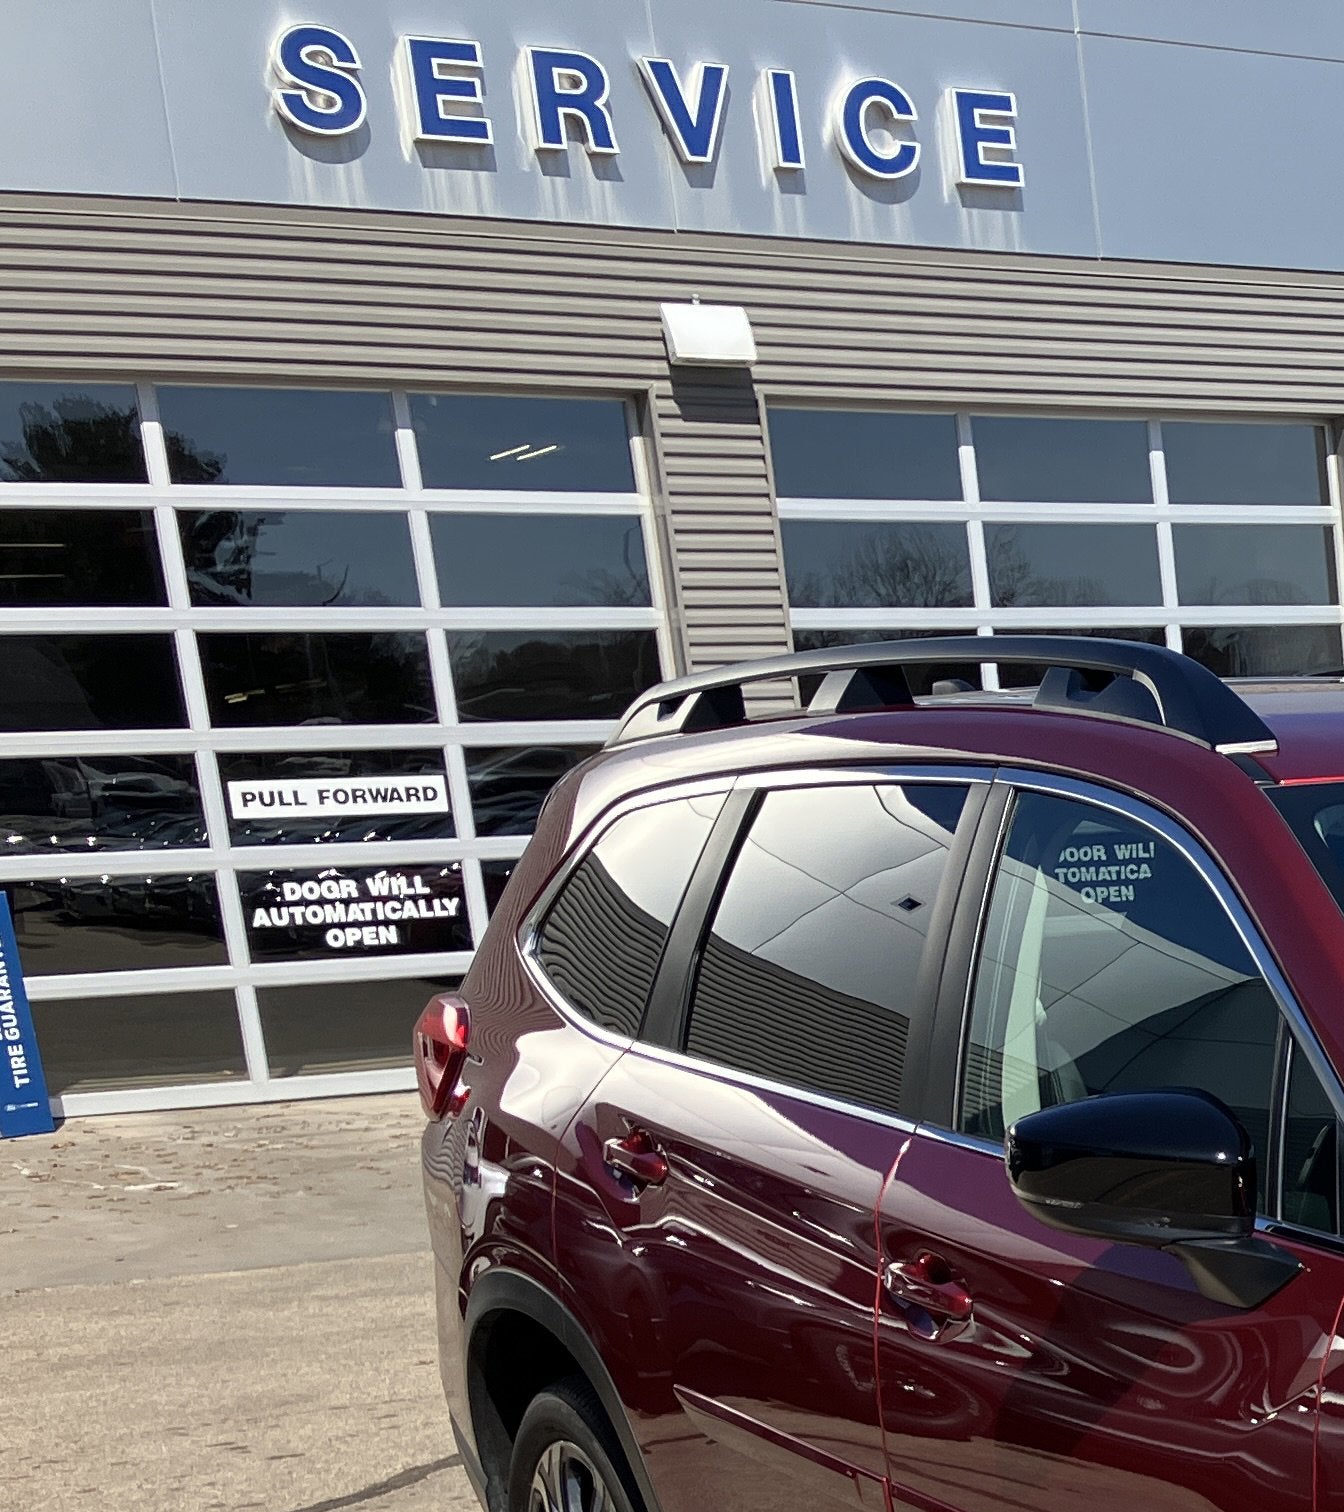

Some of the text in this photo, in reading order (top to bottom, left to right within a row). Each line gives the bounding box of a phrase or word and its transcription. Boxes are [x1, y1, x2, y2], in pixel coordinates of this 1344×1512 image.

[272, 23, 1025, 188] SERVICE
[240, 786, 439, 808] PULL FORWARD
[282, 875, 431, 901] DOOR WILL
[1080, 885, 1135, 904] OPEN
[252, 897, 460, 928] AUTOMATICALLY
[325, 925, 398, 948] OPEN
[0, 941, 31, 1089] TIRE GUARAN
